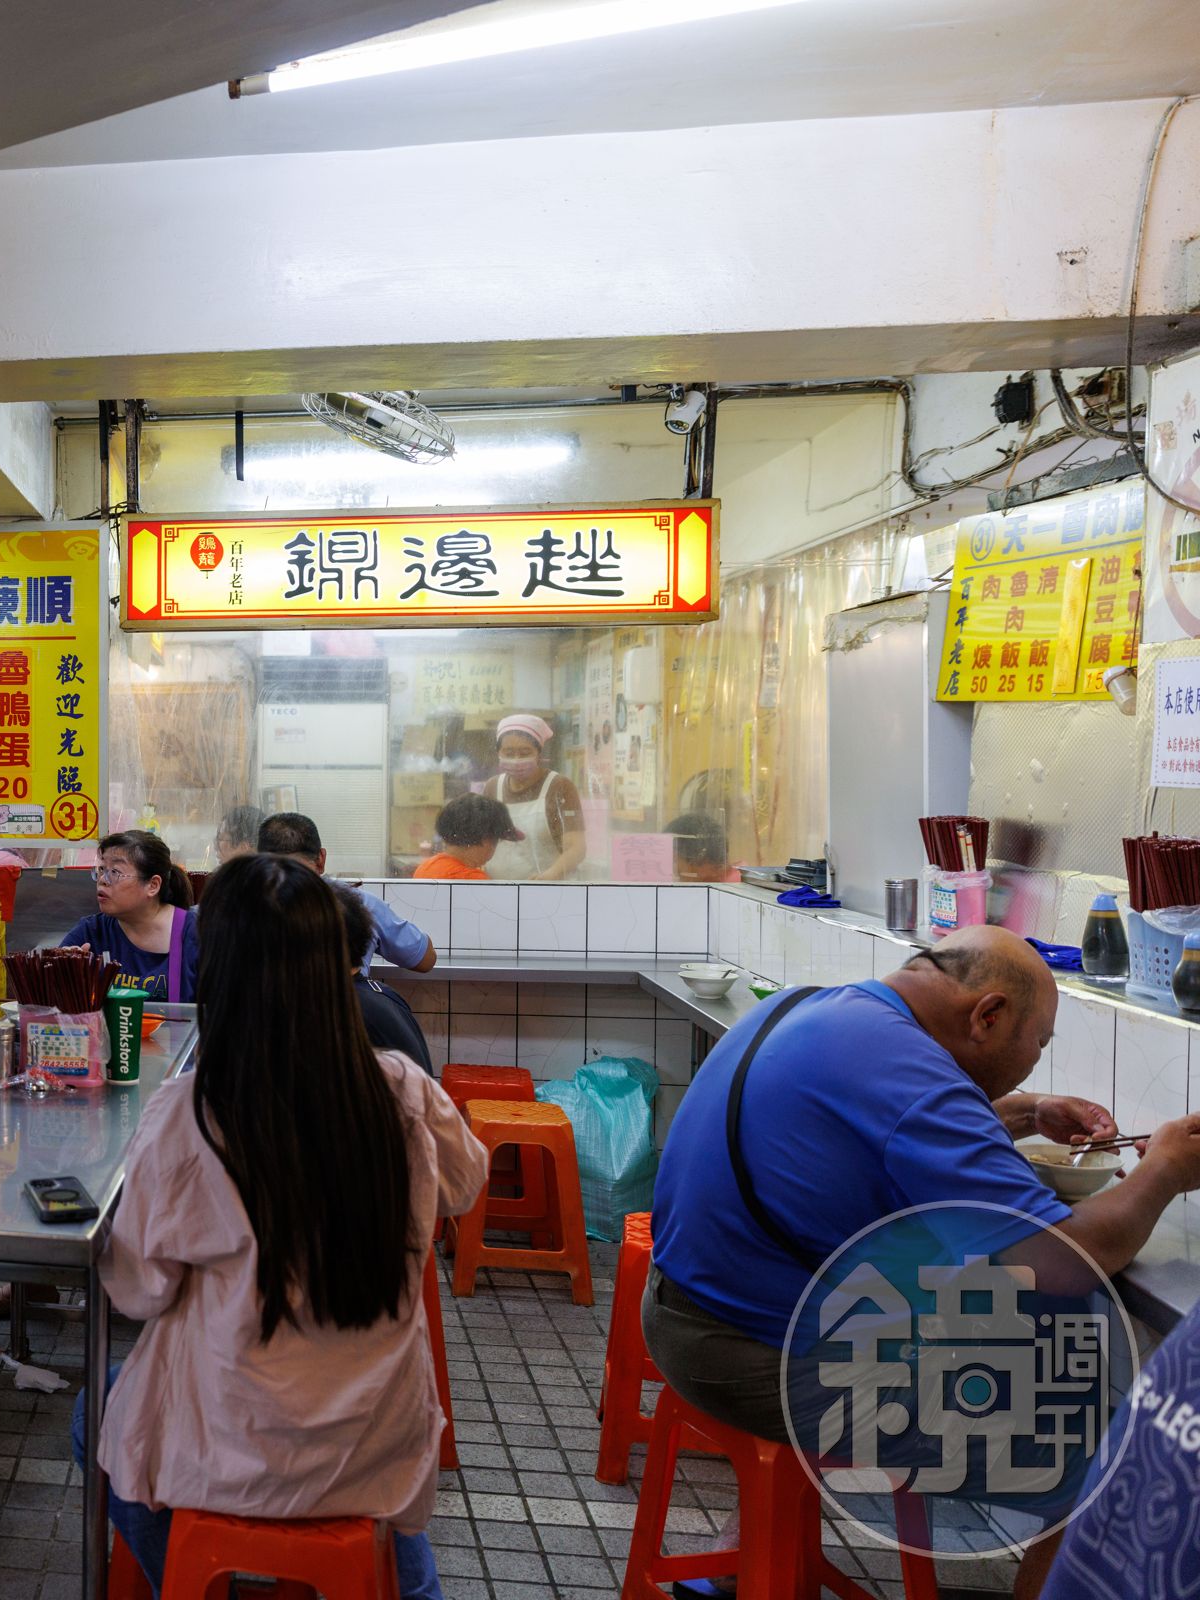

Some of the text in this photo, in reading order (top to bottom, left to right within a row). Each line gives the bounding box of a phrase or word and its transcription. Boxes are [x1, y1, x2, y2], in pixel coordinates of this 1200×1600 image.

[974, 525, 992, 553] 31
[229, 540, 244, 605] 百年老店
[943, 575, 974, 695] 百年老店
[999, 571, 1028, 669] 魯肉飯
[1029, 566, 1061, 667] 清飯
[1088, 556, 1120, 664] 油豆腐
[971, 675, 988, 694] 50
[998, 674, 1016, 693] 25
[1027, 673, 1043, 692] 15
[1087, 671, 1104, 691] 15
[56, 653, 85, 794] 歡迎光臨
[57, 801, 89, 832] 31
[118, 1005, 133, 1075] Drinkstore
